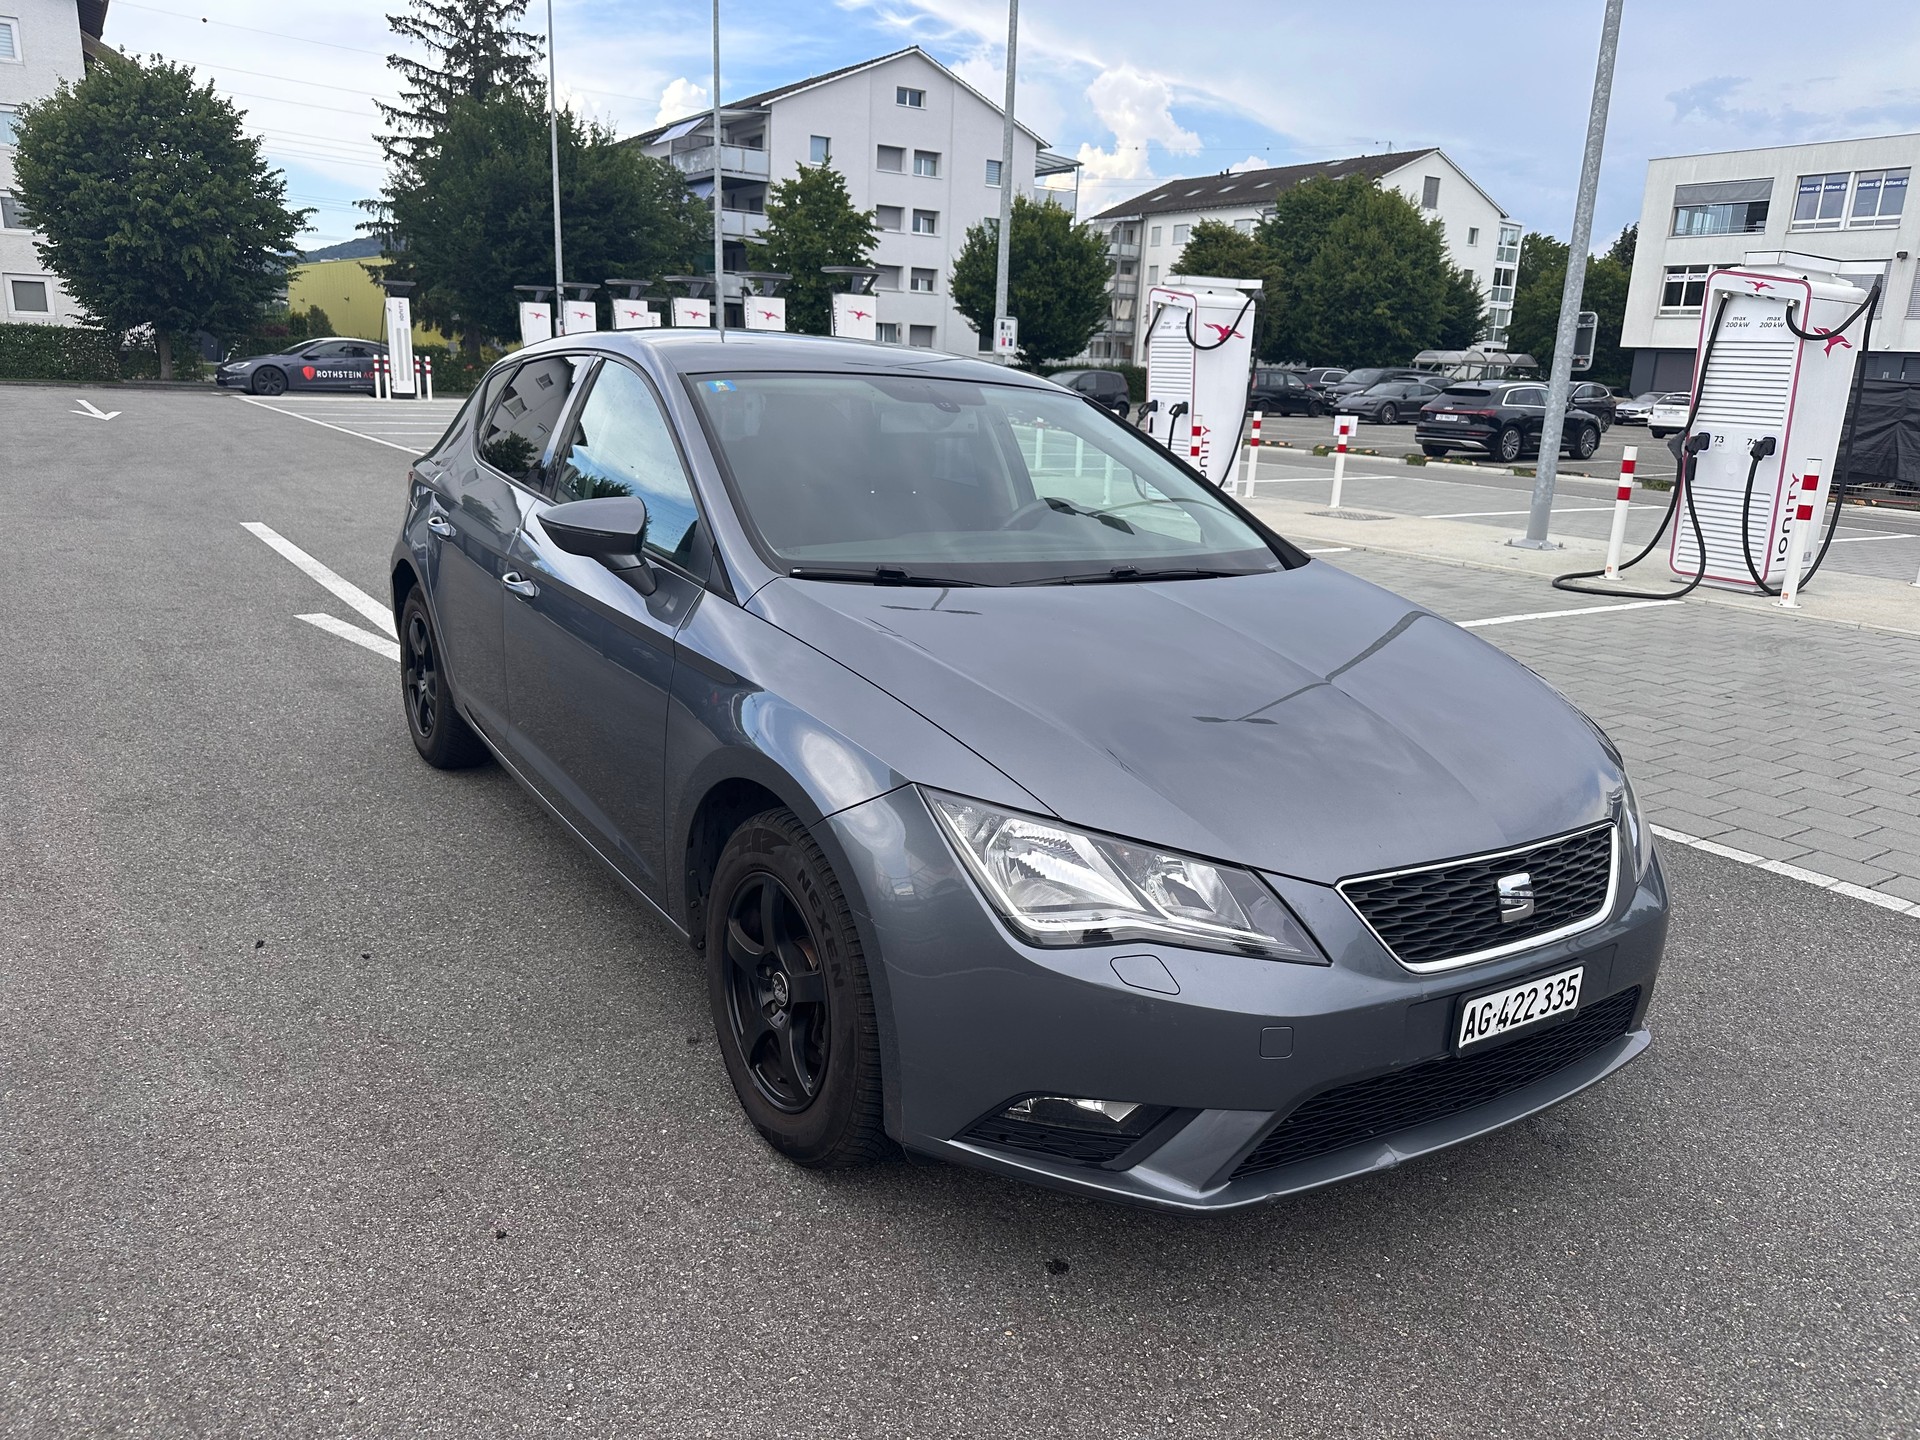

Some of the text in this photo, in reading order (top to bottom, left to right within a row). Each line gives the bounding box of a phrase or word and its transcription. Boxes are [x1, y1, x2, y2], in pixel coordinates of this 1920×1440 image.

[316, 370, 362, 379] ROTHSTEIN
[1200, 426, 1211, 478] NITY
[1714, 435, 1724, 443] 73
[1776, 473, 1799, 562] IONITY
[798, 868, 845, 989] NEXEN
